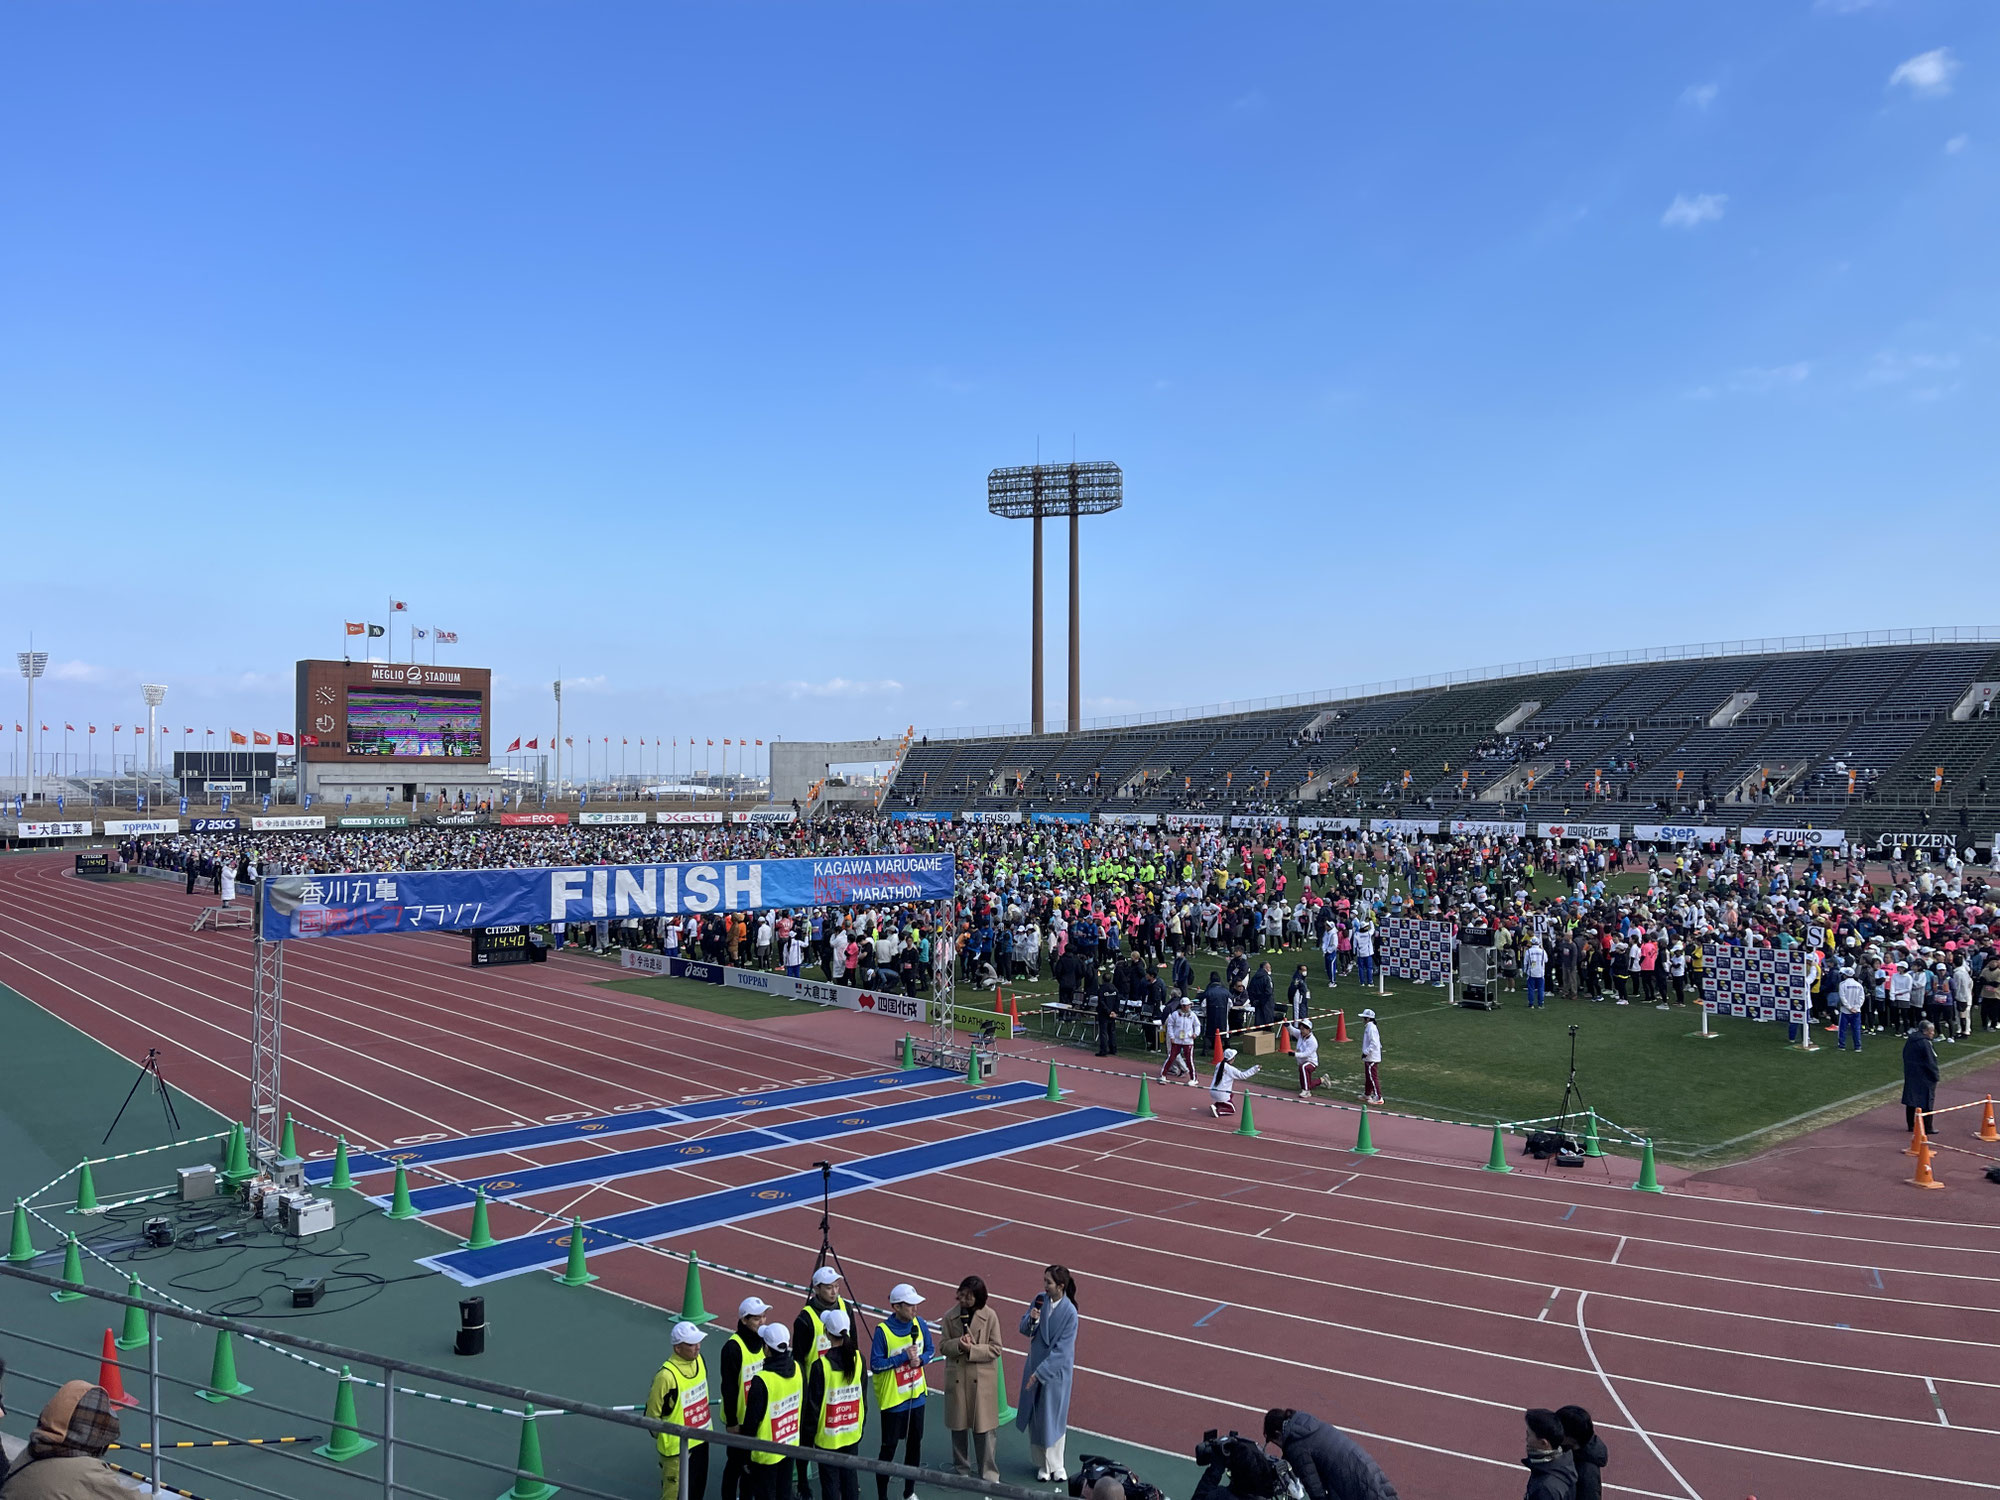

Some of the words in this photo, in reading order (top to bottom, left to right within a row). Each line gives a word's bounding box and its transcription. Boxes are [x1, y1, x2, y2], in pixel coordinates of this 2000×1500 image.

[371, 669, 404, 680] MEGLIO
[425, 671, 461, 682] STADIUM
[373, 817, 406, 825] FOREST
[436, 815, 474, 824] Sunfield
[532, 814, 555, 823] ECC
[605, 814, 639, 822] 日本道路
[665, 813, 715, 822] Xacti
[39, 823, 83, 835] 大倉工業
[122, 823, 161, 831] TOPPAN
[1567, 825, 1608, 837] 四国化成
[1661, 826, 1696, 840] Step
[1880, 832, 1957, 848] CITIZEN
[813, 860, 873, 876] KAGAWA
[875, 857, 943, 874] MARUGAME
[813, 873, 916, 890] INTERNATIONAL
[298, 878, 399, 905] 香川丸亀
[550, 864, 763, 920] FINISH
[814, 888, 850, 904] HALF
[852, 885, 922, 902] MARATHON
[1363, 888, 1374, 903] Q
[299, 902, 482, 933] 国際ハーフマラソン
[1534, 915, 1547, 932] R
[485, 925, 520, 935] CITIZEN
[1807, 927, 1822, 946] S
[692, 966, 709, 978] asics
[737, 973, 768, 988] TOPPAN
[803, 984, 838, 1003] 大倉工業
[877, 996, 917, 1018] 四国化成
